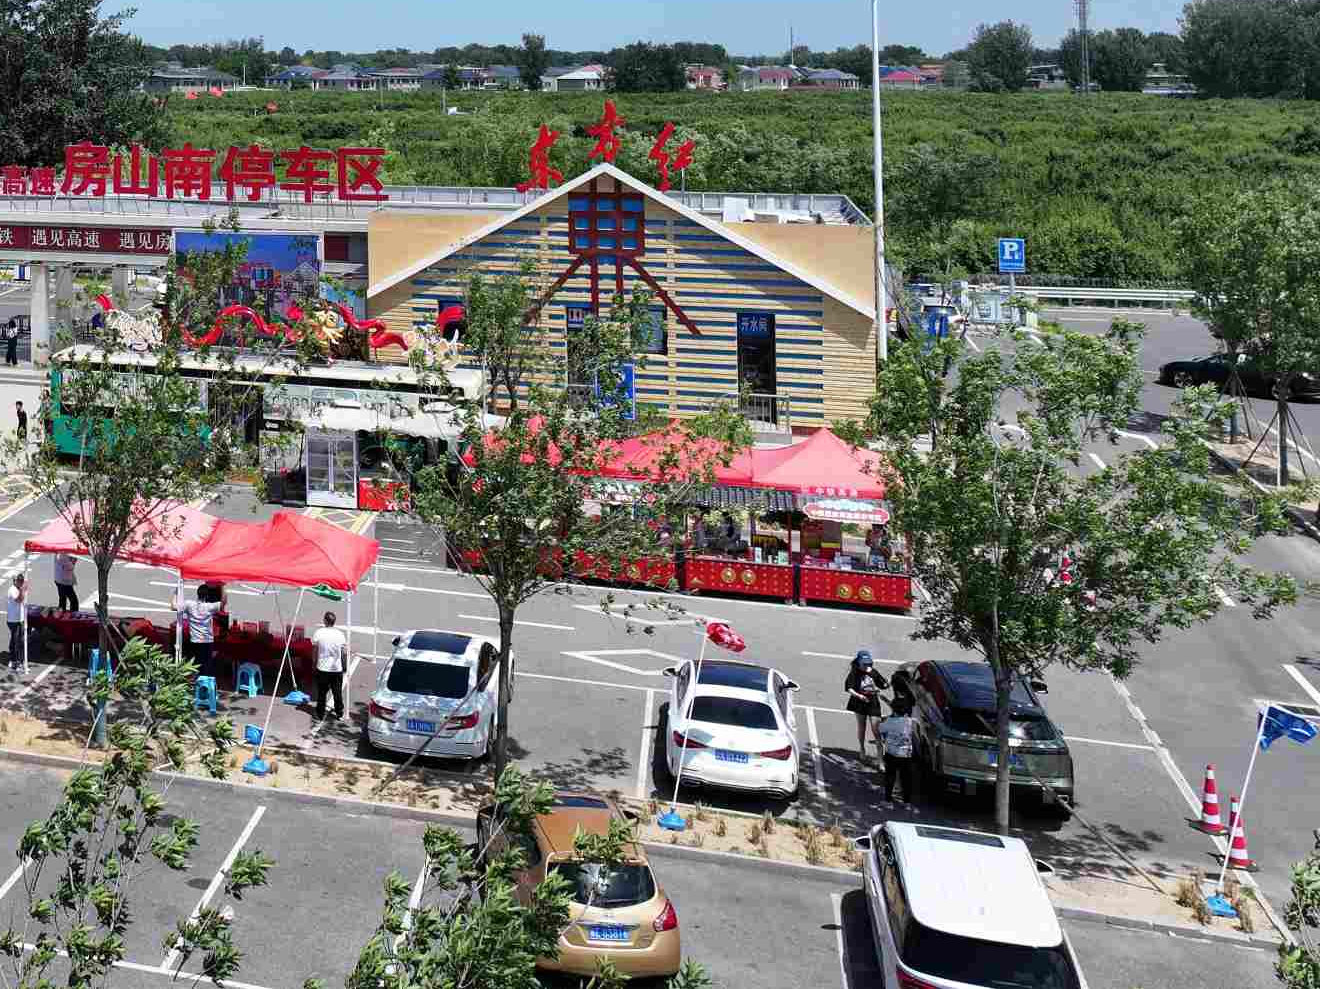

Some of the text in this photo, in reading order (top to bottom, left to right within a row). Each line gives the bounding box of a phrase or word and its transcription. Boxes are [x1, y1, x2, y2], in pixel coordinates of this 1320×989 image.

[61, 141, 391, 203] 房山南停车区
[31, 229, 101, 248] 遇见高速
